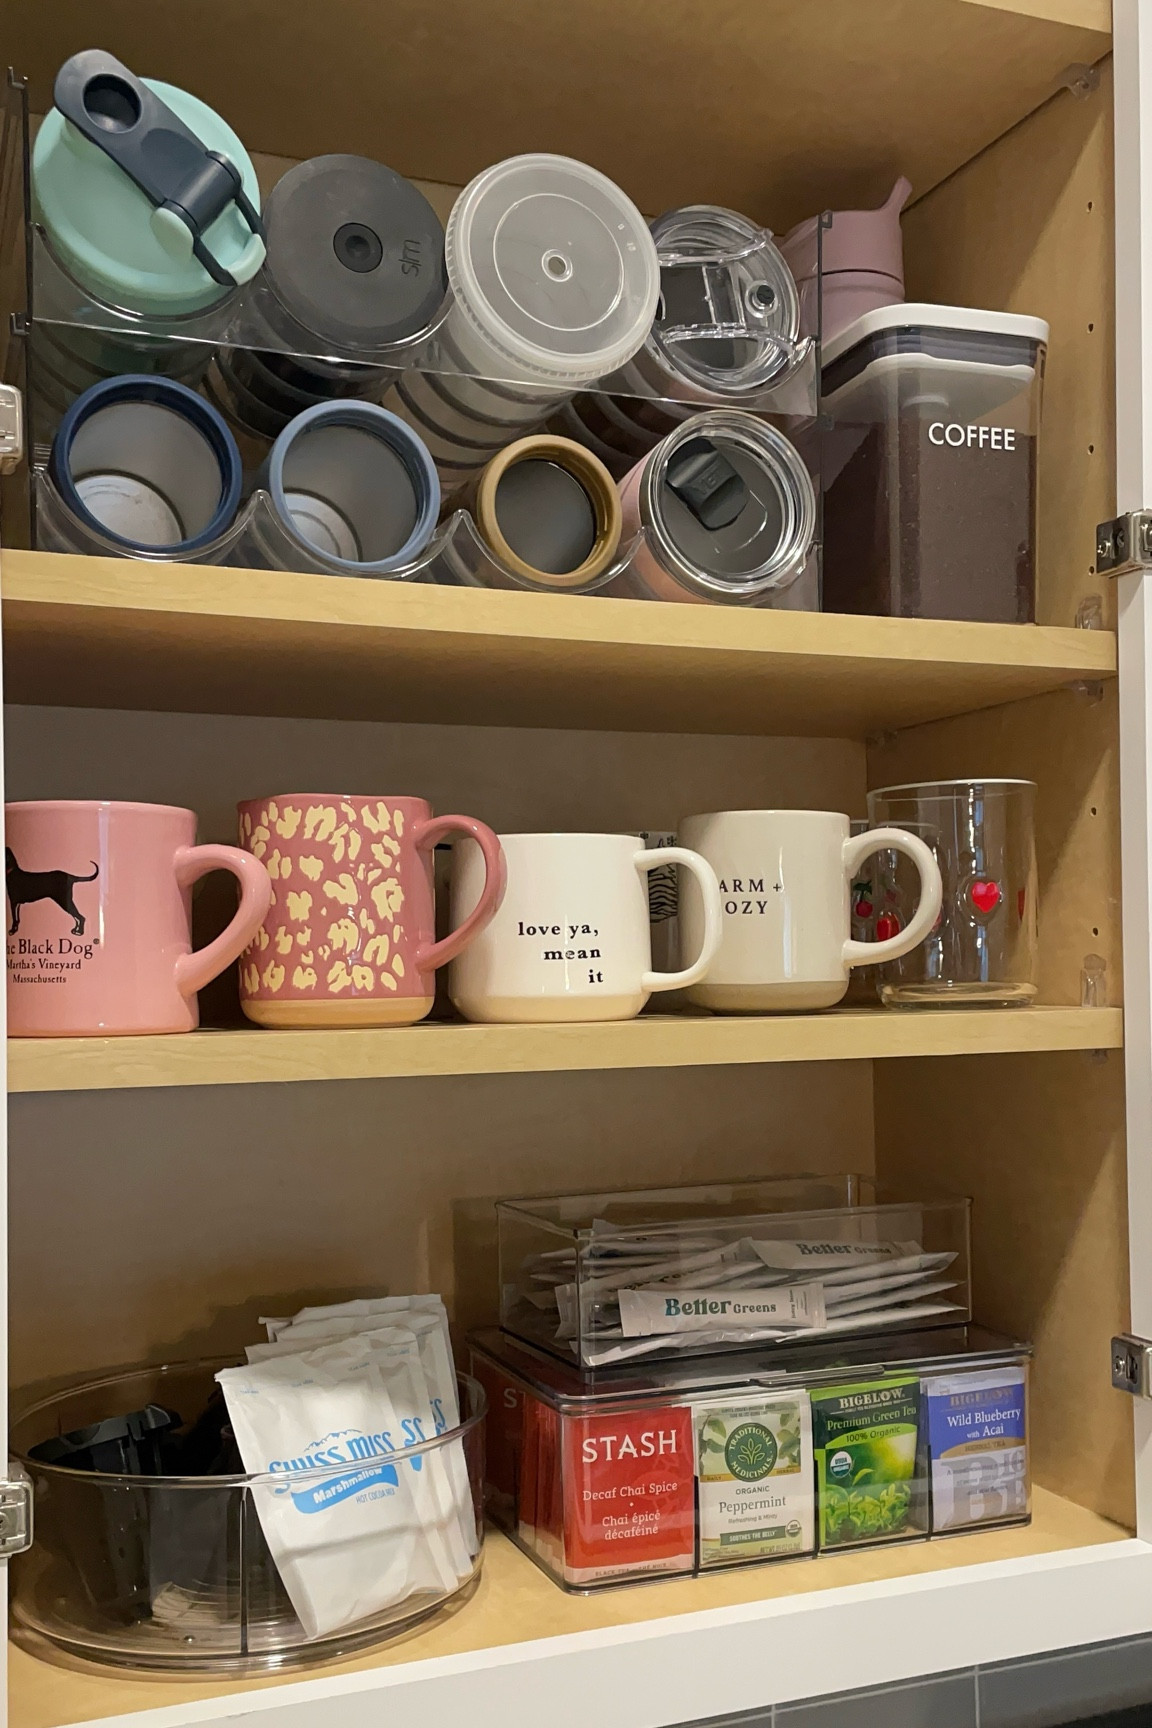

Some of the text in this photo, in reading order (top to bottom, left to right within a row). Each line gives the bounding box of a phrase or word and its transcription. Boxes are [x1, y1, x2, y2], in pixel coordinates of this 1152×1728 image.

[928, 422, 1016, 451] COFFEE
[719, 878, 765, 893] ARM
[724, 900, 768, 915] OZY
[518, 921, 599, 940] love ya,
[18, 938, 54, 955] Black
[543, 948, 601, 961] mean
[38, 957, 82, 973] Vineyard
[12, 974, 68, 984] Massachusetts
[588, 968, 604, 984] it
[796, 1242, 852, 1256] Better
[664, 1297, 732, 1317] Better
[732, 1303, 777, 1314] Greens
[838, 1387, 904, 1409] BIGELOW
[826, 1417, 871, 1431] Premium
[872, 1409, 901, 1423] Green
[902, 1405, 917, 1416] Tea
[946, 1408, 1021, 1428] Wild Blueberry
[728, 1426, 773, 1451] TRADITIONAL
[845, 1426, 901, 1443] 100% Organic
[966, 1424, 1005, 1439] with Acai
[582, 1429, 677, 1463] STASH
[731, 1456, 774, 1479] MEDICINALS
[312, 1467, 383, 1504] Marshmallow
[582, 1481, 678, 1502] Decaf Chai Spice
[735, 1485, 771, 1496] ORGANIC
[719, 1495, 787, 1516] Peppermint
[602, 1508, 662, 1528] Chai épicé
[604, 1524, 660, 1541] décaféiné
